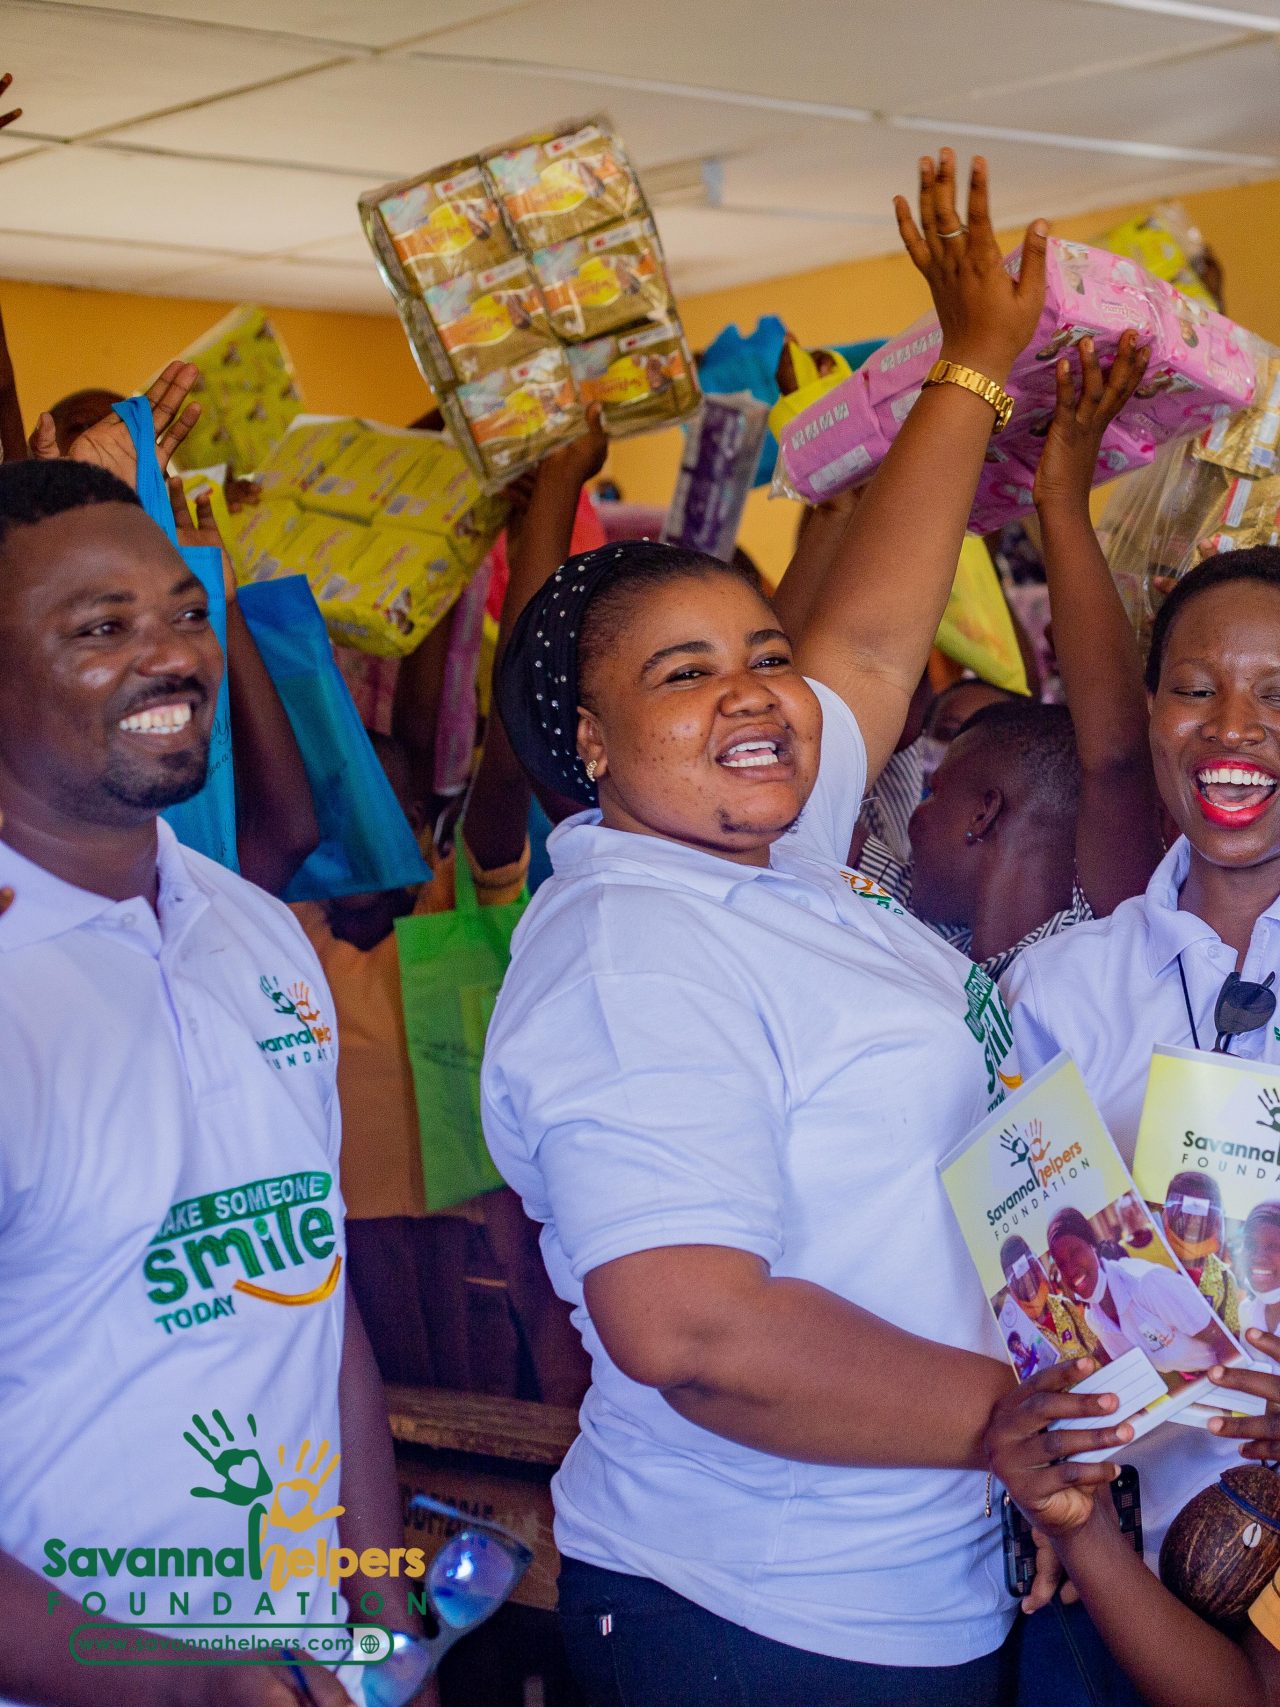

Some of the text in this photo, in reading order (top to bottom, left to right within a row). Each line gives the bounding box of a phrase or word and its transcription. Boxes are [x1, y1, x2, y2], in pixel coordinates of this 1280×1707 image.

[159, 1175, 326, 1237] AKE SOMEONE
[994, 1157, 1091, 1241] FOUNDATION
[143, 1206, 336, 1306] smile
[154, 1294, 236, 1335] TODAY
